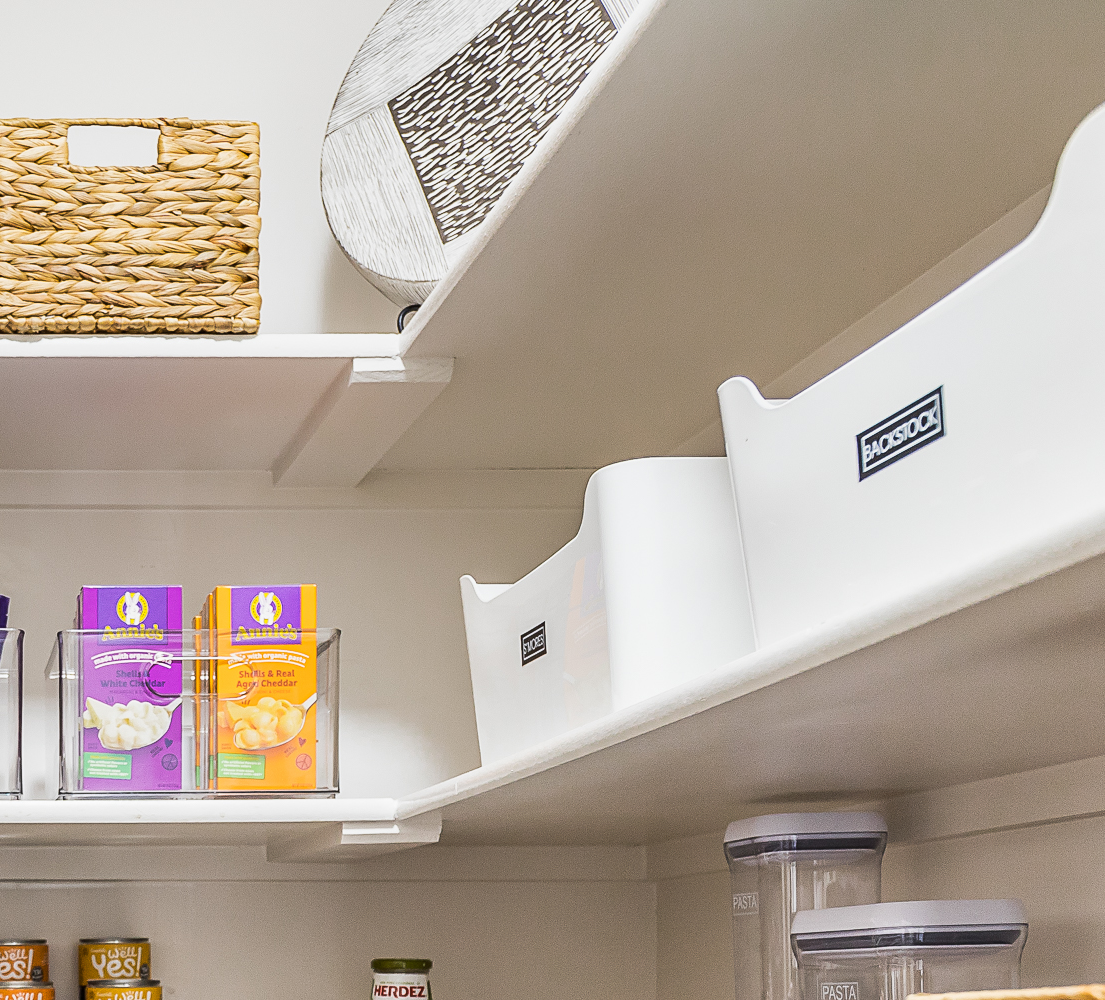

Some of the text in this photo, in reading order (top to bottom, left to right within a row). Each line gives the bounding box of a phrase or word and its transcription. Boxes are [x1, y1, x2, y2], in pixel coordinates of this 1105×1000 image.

[863, 406, 938, 463] BACKSTOCK
[101, 623, 164, 642] Annie's
[235, 623, 298, 641] Annie's
[523, 633, 544, 655] S'MORES
[113, 653, 128, 661] with
[129, 653, 154, 661] organic
[288, 654, 307, 664] pasta
[116, 670, 141, 678] Shells
[239, 670, 265, 678] Shells
[276, 669, 295, 678] Real
[100, 680, 166, 688] White Cheddar
[261, 679, 298, 688] Cheddar
[733, 894, 757, 911] PASTA
[107, 946, 137, 960] well
[91, 946, 142, 979] Yes!
[373, 984, 426, 999] HERDEZ
[822, 985, 857, 1000] PASTA
